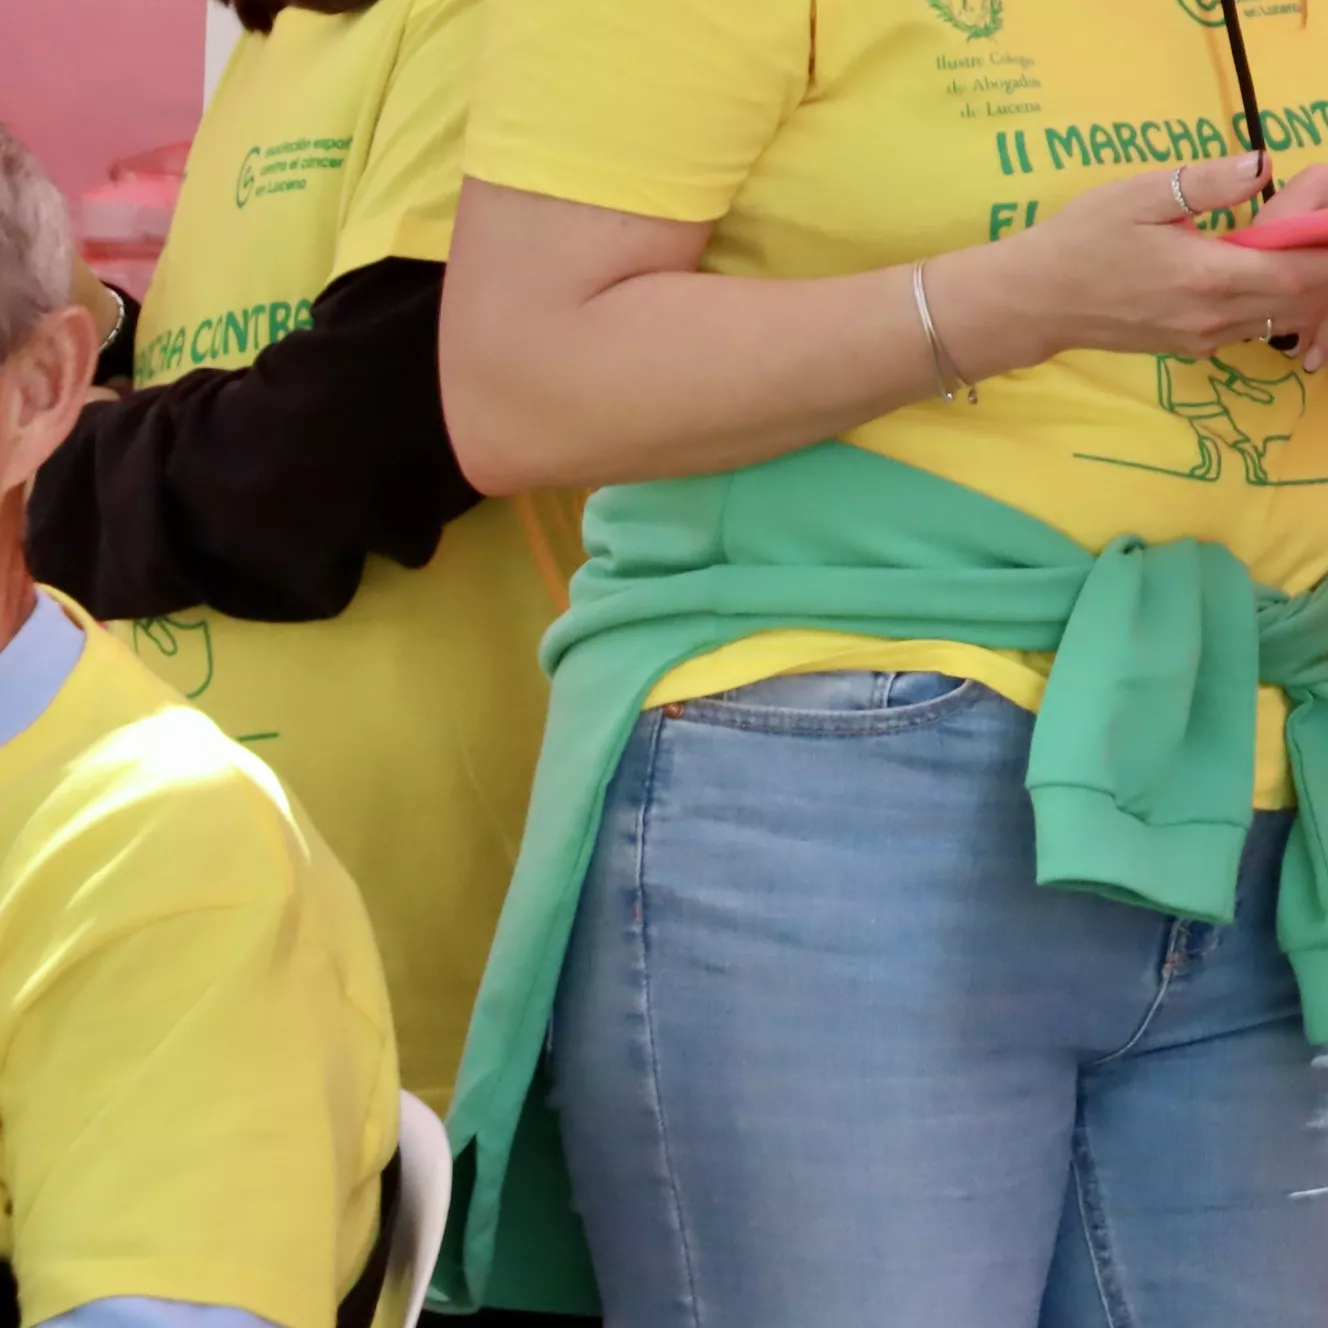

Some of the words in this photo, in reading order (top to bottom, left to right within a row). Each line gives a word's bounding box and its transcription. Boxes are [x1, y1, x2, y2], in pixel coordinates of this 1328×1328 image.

[986, 100, 1042, 118] Lucena
[996, 129, 1034, 176] II
[1044, 115, 1228, 171] MARCHA
